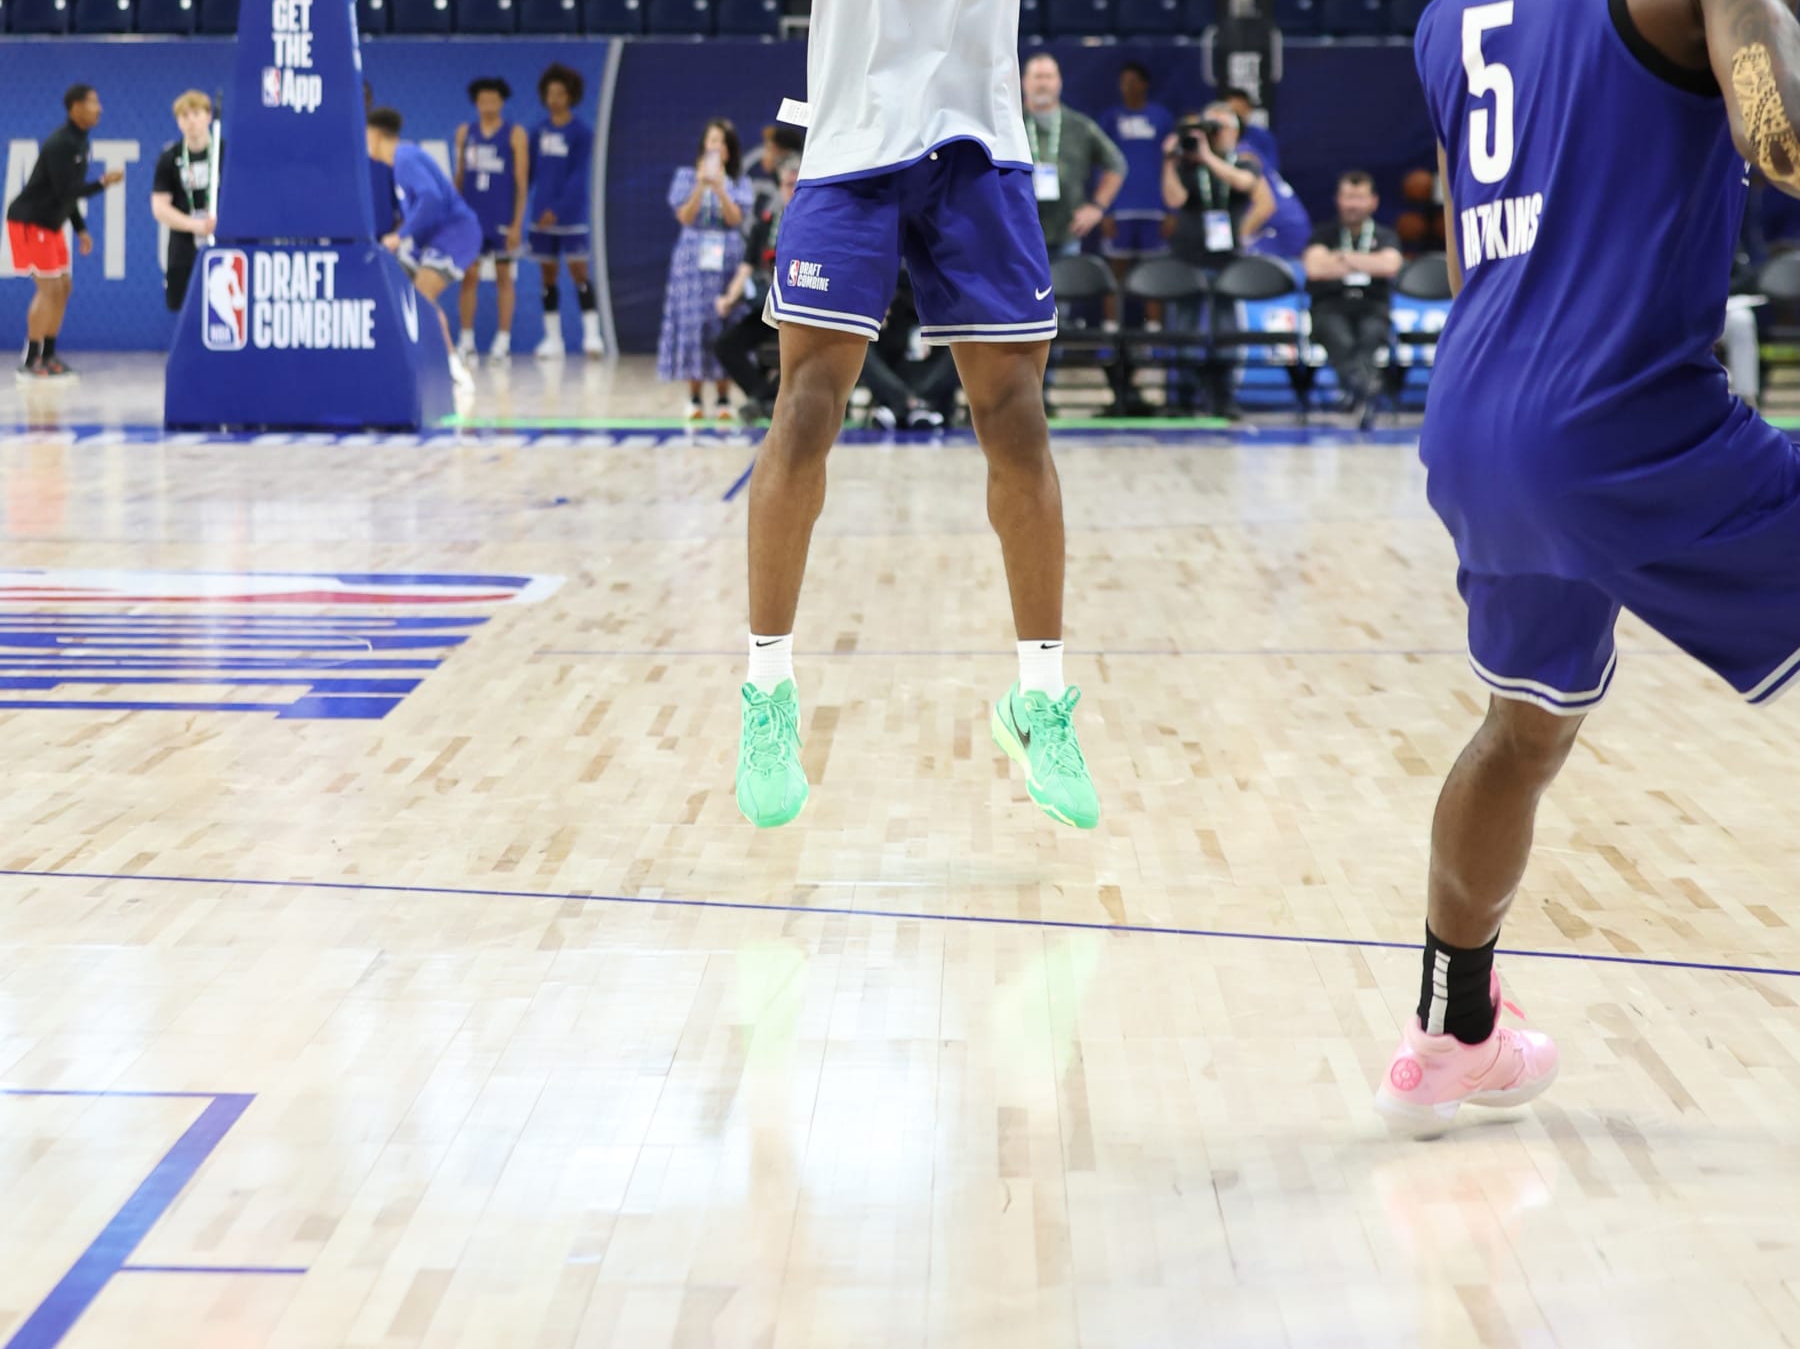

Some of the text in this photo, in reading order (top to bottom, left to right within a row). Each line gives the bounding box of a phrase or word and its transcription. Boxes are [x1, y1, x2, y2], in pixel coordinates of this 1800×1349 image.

[271, 31, 313, 68] THE
[281, 68, 322, 113] App
[1462, 0, 1514, 184] 5
[253, 251, 339, 300] DRAFT
[797, 275, 830, 292] COMBINE
[800, 261, 822, 277] DRAFT
[253, 299, 376, 349] COMBINE
